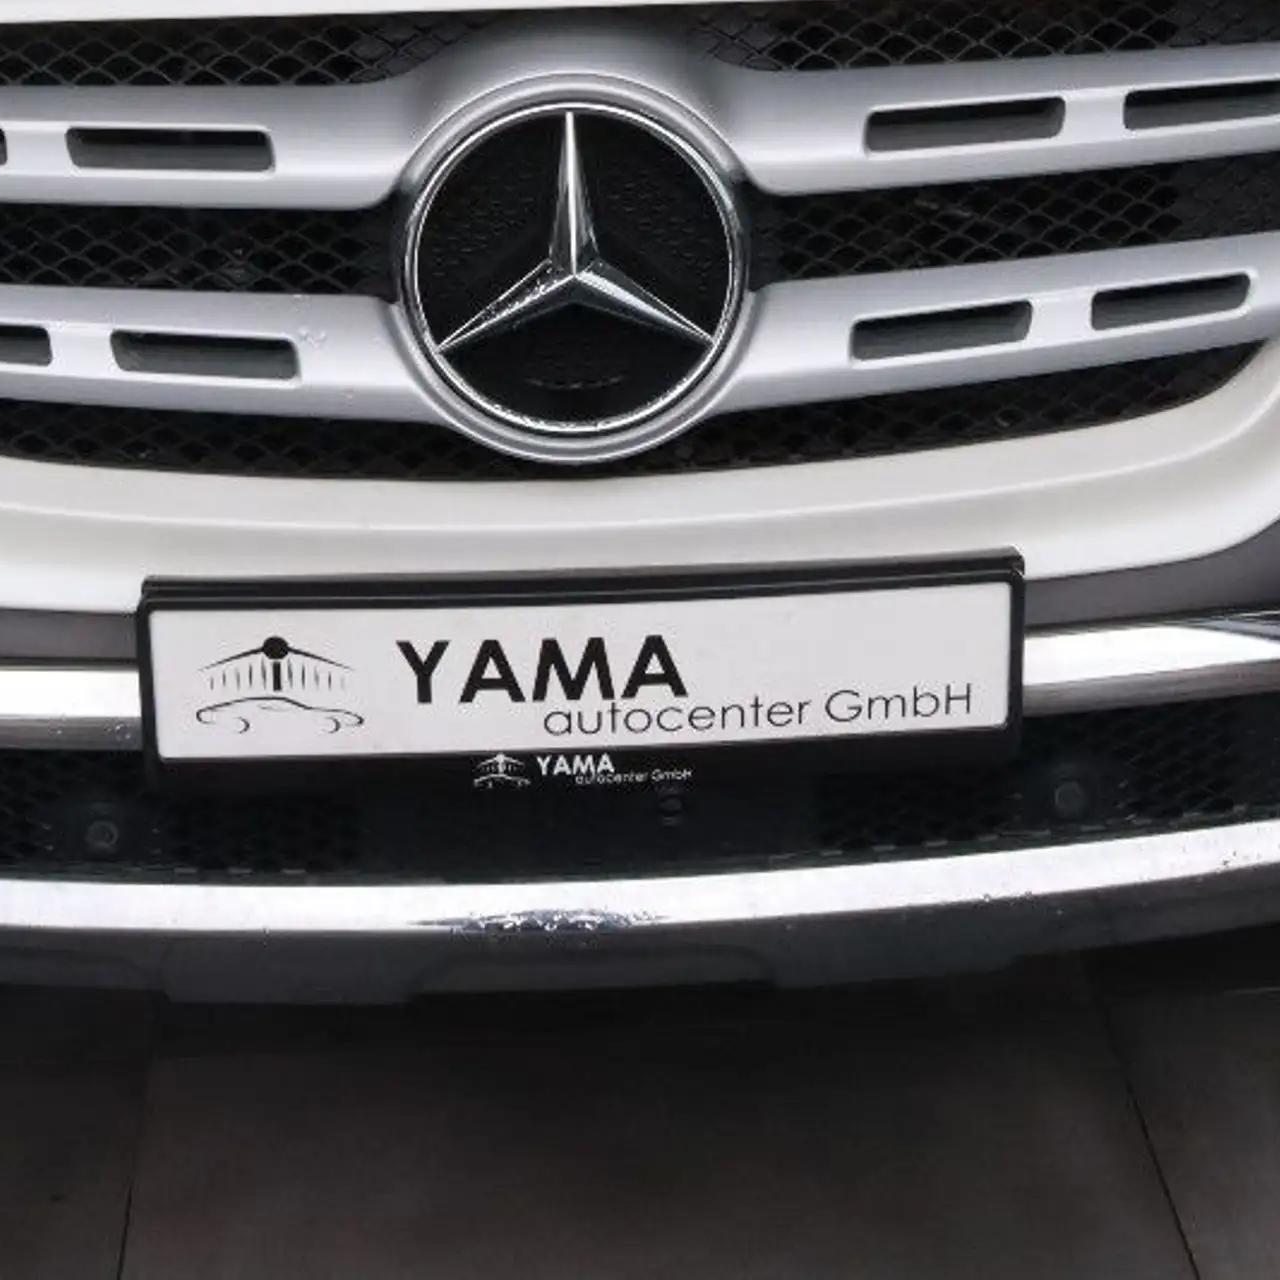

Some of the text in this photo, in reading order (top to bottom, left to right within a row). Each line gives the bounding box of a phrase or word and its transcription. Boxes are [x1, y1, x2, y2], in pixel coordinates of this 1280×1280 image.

[396, 634, 689, 704] YAMA
[543, 683, 972, 736] autocenter GmbH
[536, 753, 616, 776] YAMA
[575, 767, 693, 785] autocenter GmbH
